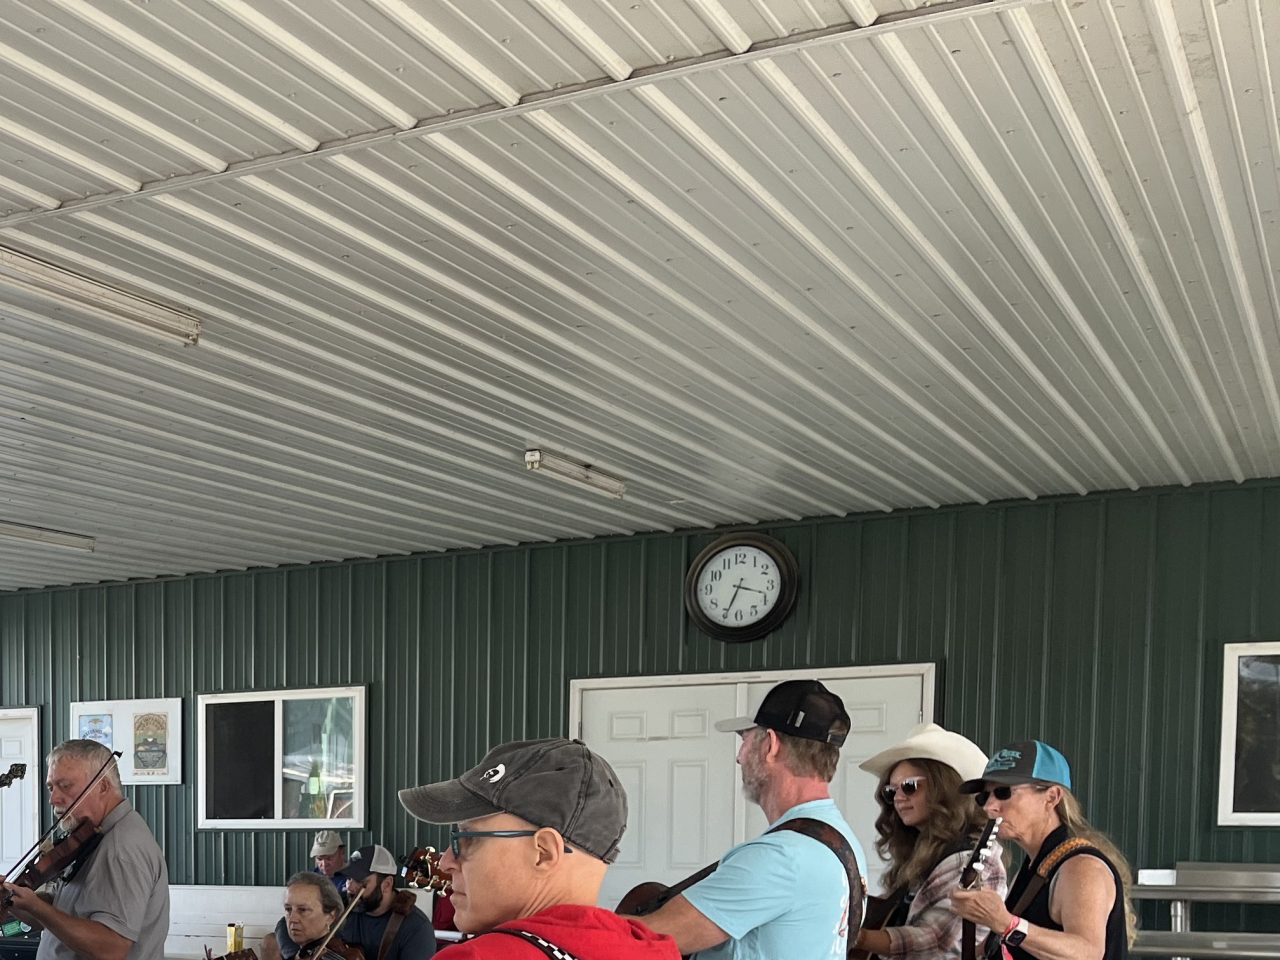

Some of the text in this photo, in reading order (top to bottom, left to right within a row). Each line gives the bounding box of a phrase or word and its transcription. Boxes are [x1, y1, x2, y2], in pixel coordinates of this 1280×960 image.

[722, 558, 731, 570] 11
[734, 553, 747, 565] 12
[711, 570, 722, 582] 10
[761, 564, 769, 576] 2
[705, 584, 713, 595] 9
[766, 580, 774, 591] 3
[710, 599, 718, 609] 8
[735, 610, 743, 621] 6
[750, 605, 758, 617] 5
